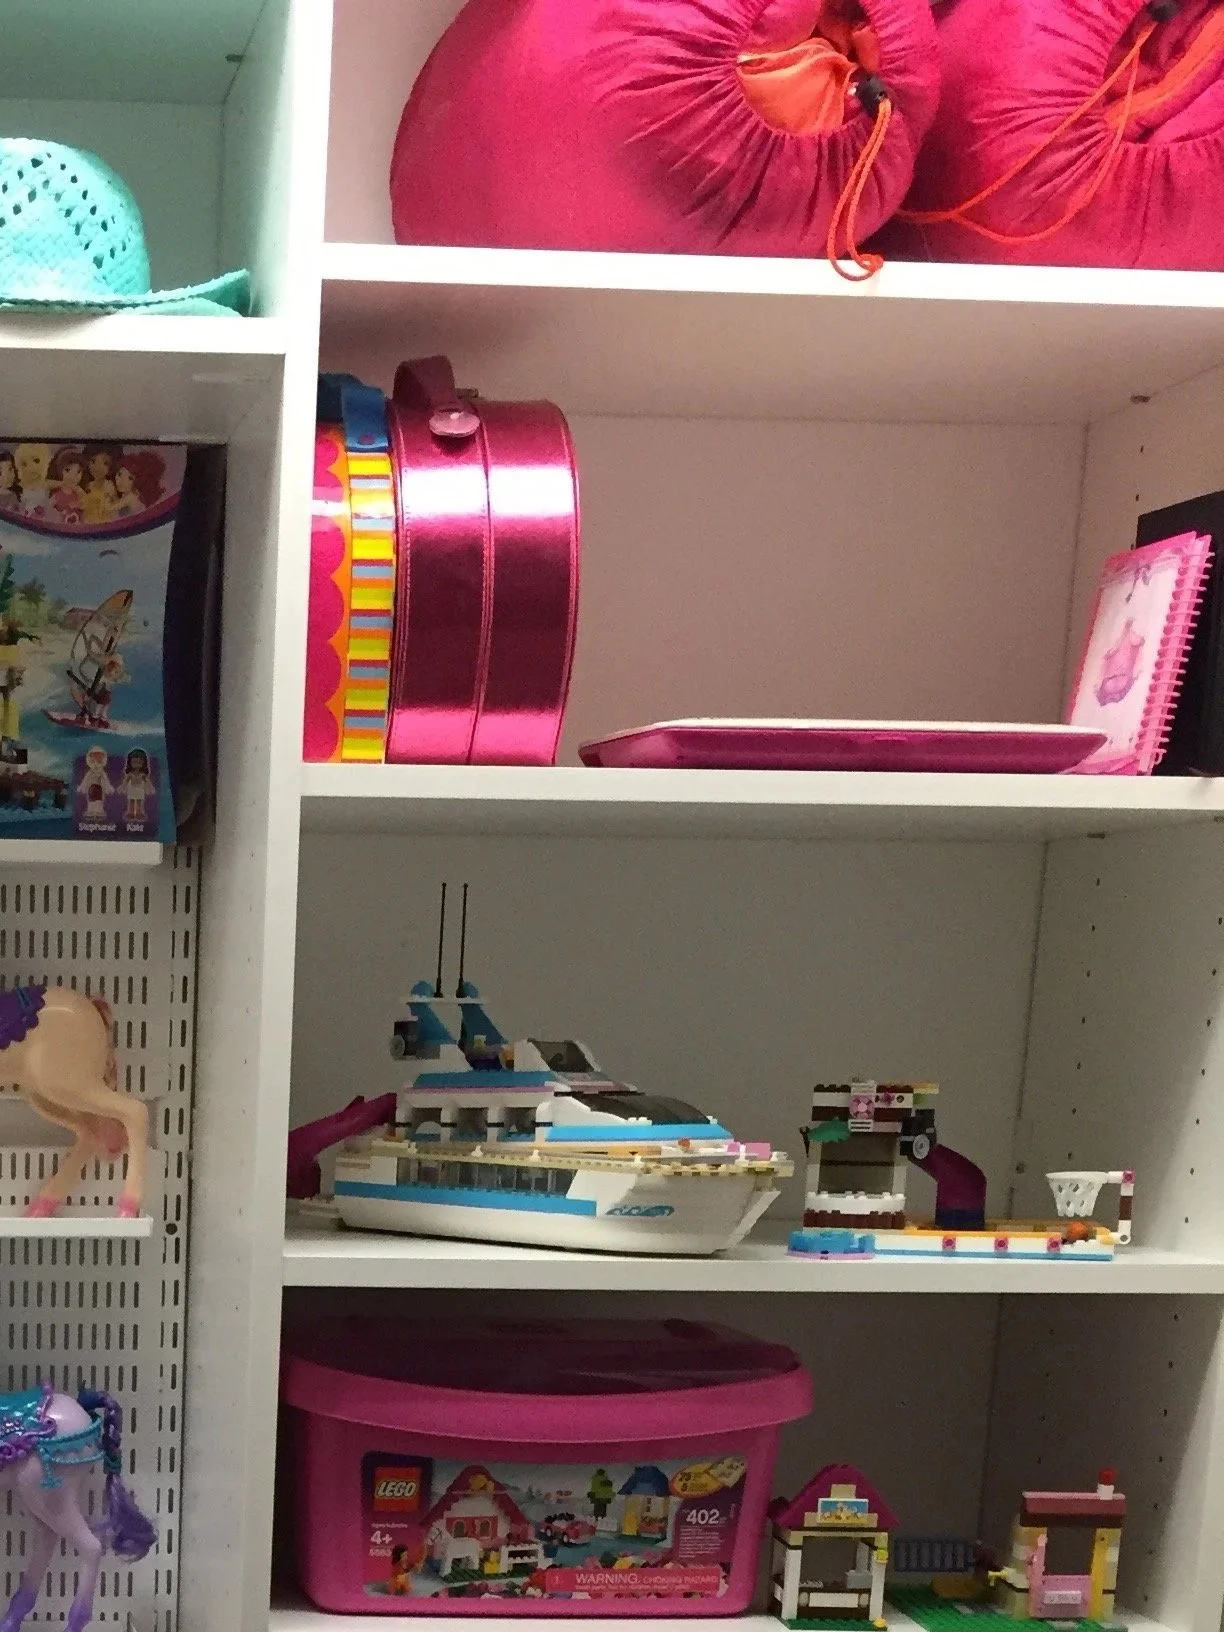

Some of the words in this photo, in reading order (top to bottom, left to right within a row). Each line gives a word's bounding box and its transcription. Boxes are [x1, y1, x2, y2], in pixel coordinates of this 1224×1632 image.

[377, 1481, 417, 1497] LEGO
[685, 1508, 720, 1525] 402
[370, 1530, 393, 1544] 4+
